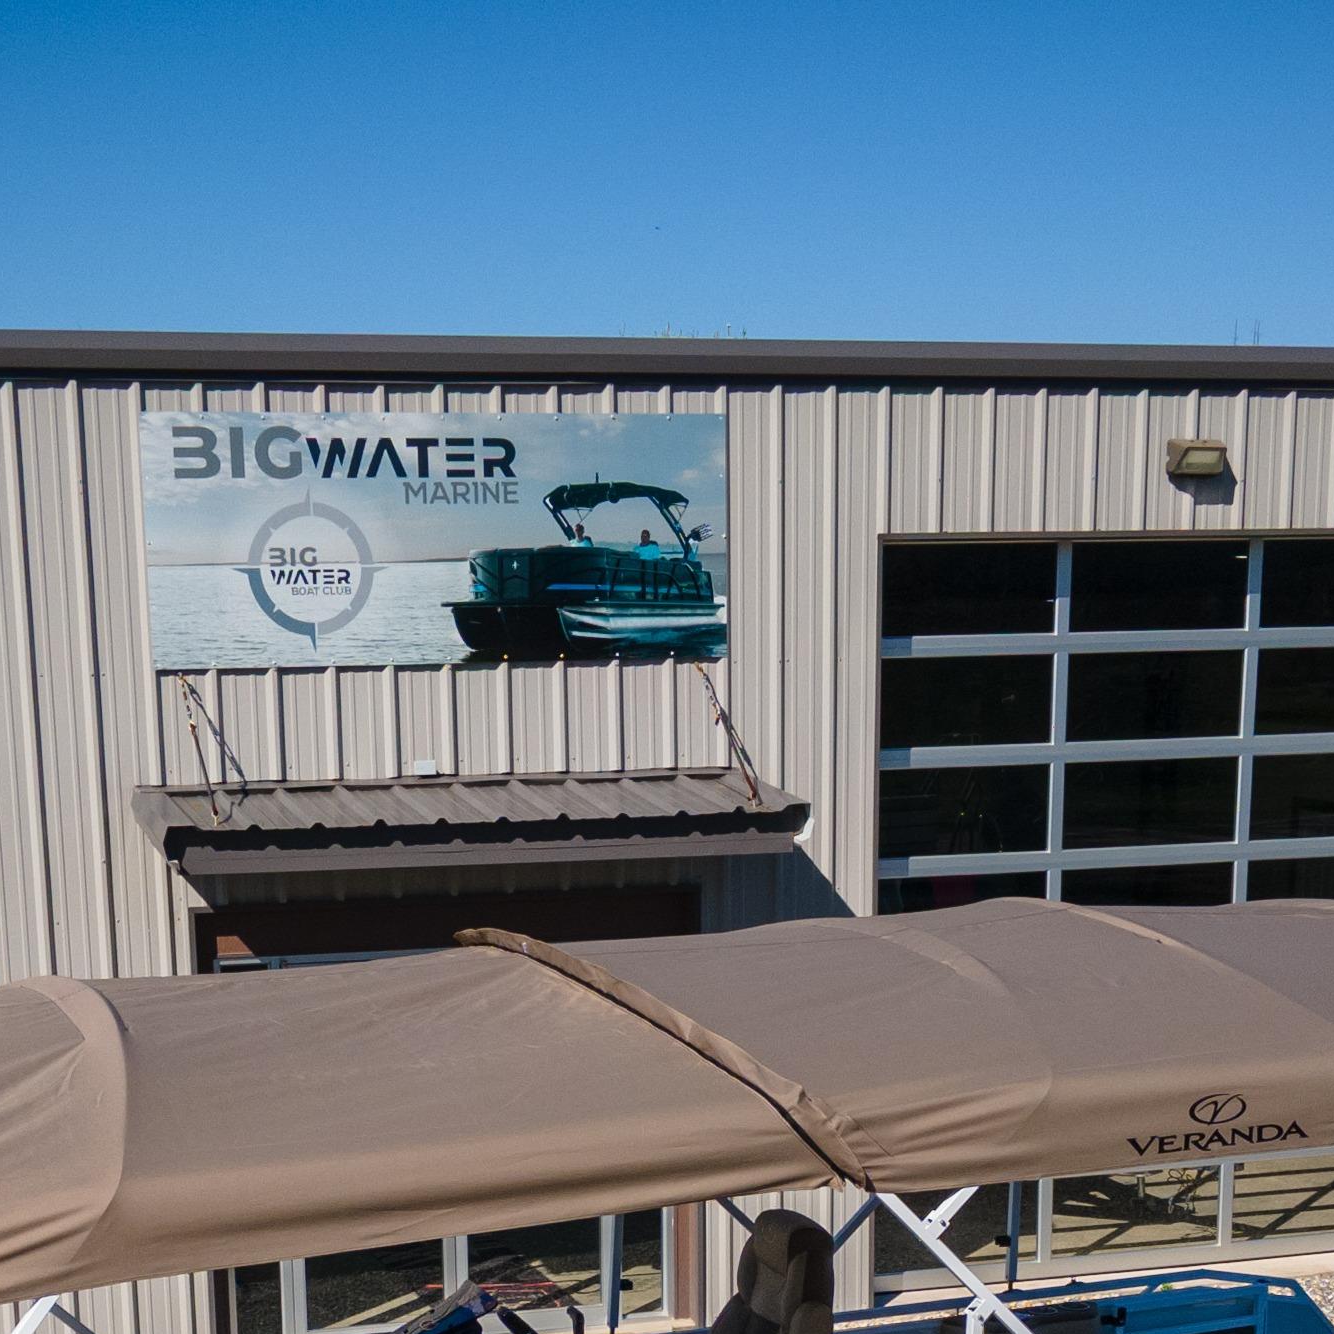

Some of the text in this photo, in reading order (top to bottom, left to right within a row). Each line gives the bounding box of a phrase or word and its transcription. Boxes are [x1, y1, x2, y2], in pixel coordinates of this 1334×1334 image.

[403, 480, 519, 505] MARINE
[268, 546, 318, 567] BIG
[270, 568, 351, 585] WATER
[290, 585, 352, 596] BOAT CLUB
[1126, 1120, 1309, 1157] VERANDA
